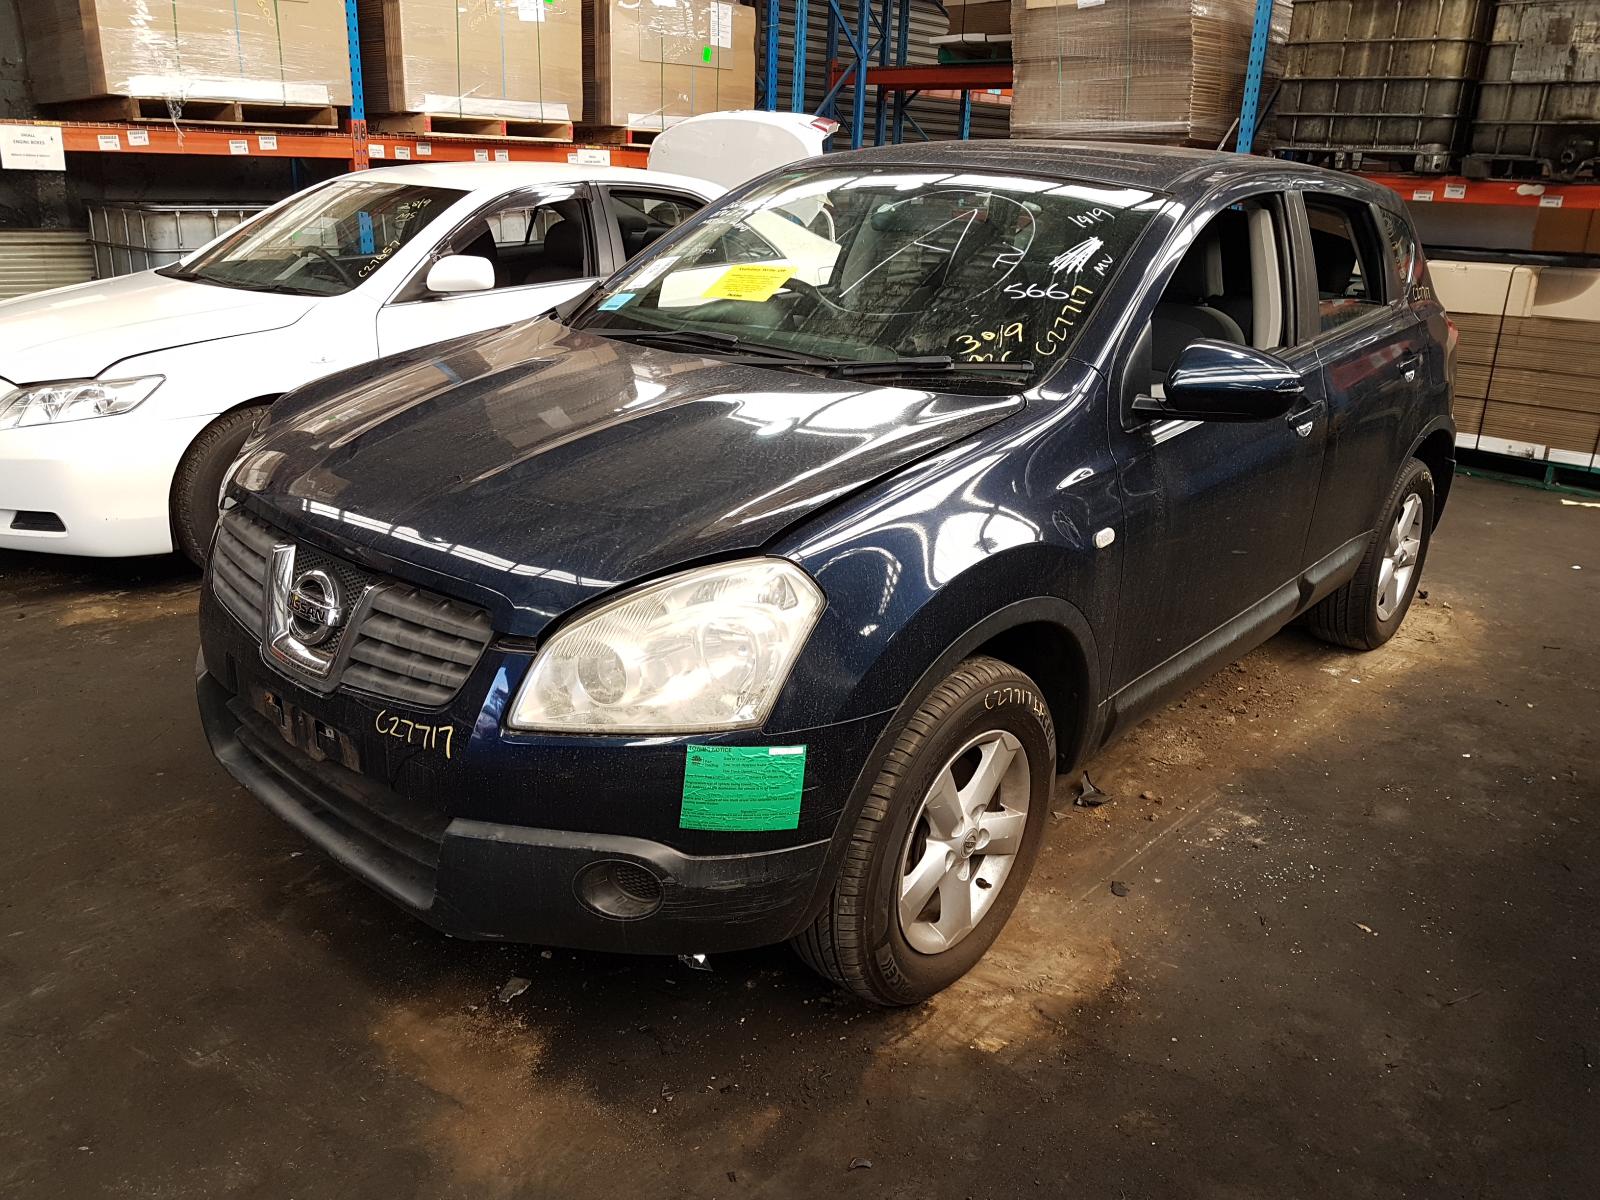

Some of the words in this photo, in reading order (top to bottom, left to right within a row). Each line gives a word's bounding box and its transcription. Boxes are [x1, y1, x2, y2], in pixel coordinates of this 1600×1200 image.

[1003, 282, 1070, 300] 566
[1035, 284, 1094, 356] C27717
[287, 591, 326, 621] NISSAN
[375, 709, 454, 760] C27717
